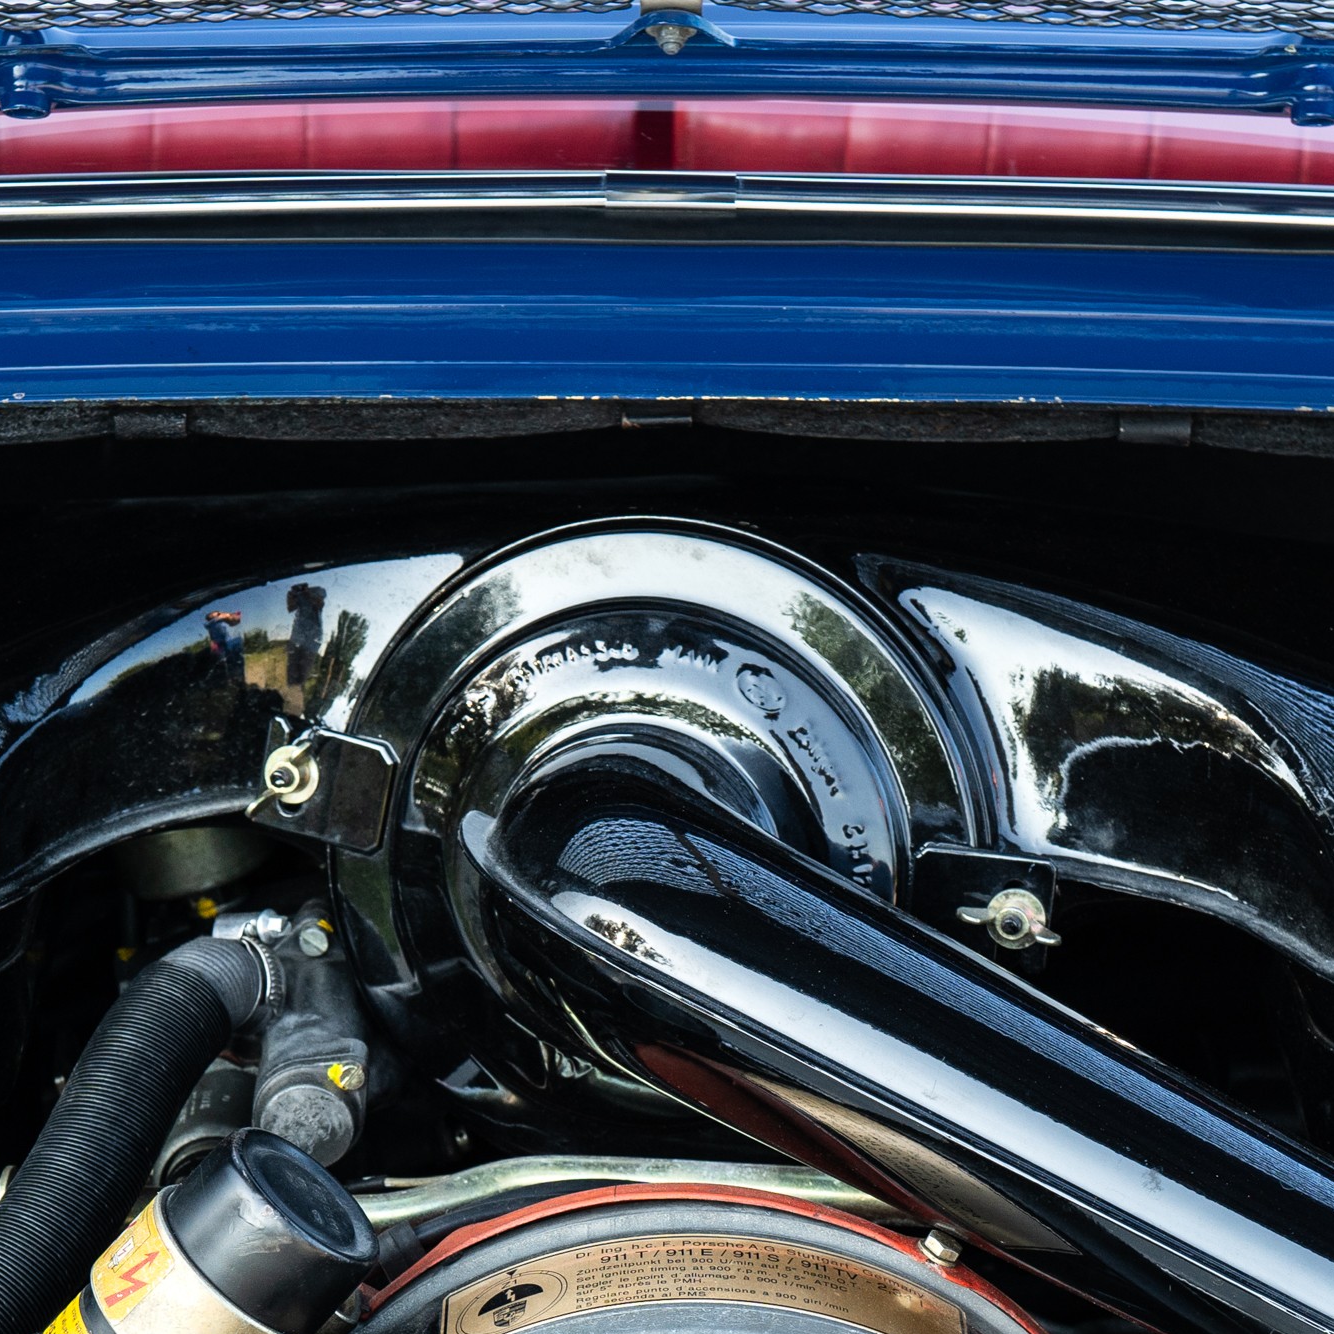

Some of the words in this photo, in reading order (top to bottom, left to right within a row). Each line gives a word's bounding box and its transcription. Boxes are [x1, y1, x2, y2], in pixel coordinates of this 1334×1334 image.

[576, 1252, 596, 1260] Dr.
[601, 1246, 626, 1255] Ing.
[682, 1240, 744, 1248] Porsche
[786, 1249, 850, 1269] Stuttgart
[862, 1268, 924, 1298] Germany
[600, 1254, 628, 1264] 911
[666, 1249, 694, 1257] 911
[733, 1250, 760, 1259] 911
[801, 1260, 827, 1272] 911
[601, 1268, 644, 1278] ignition
[650, 1264, 686, 1274] timing
[814, 1278, 848, 1292] ATDC
